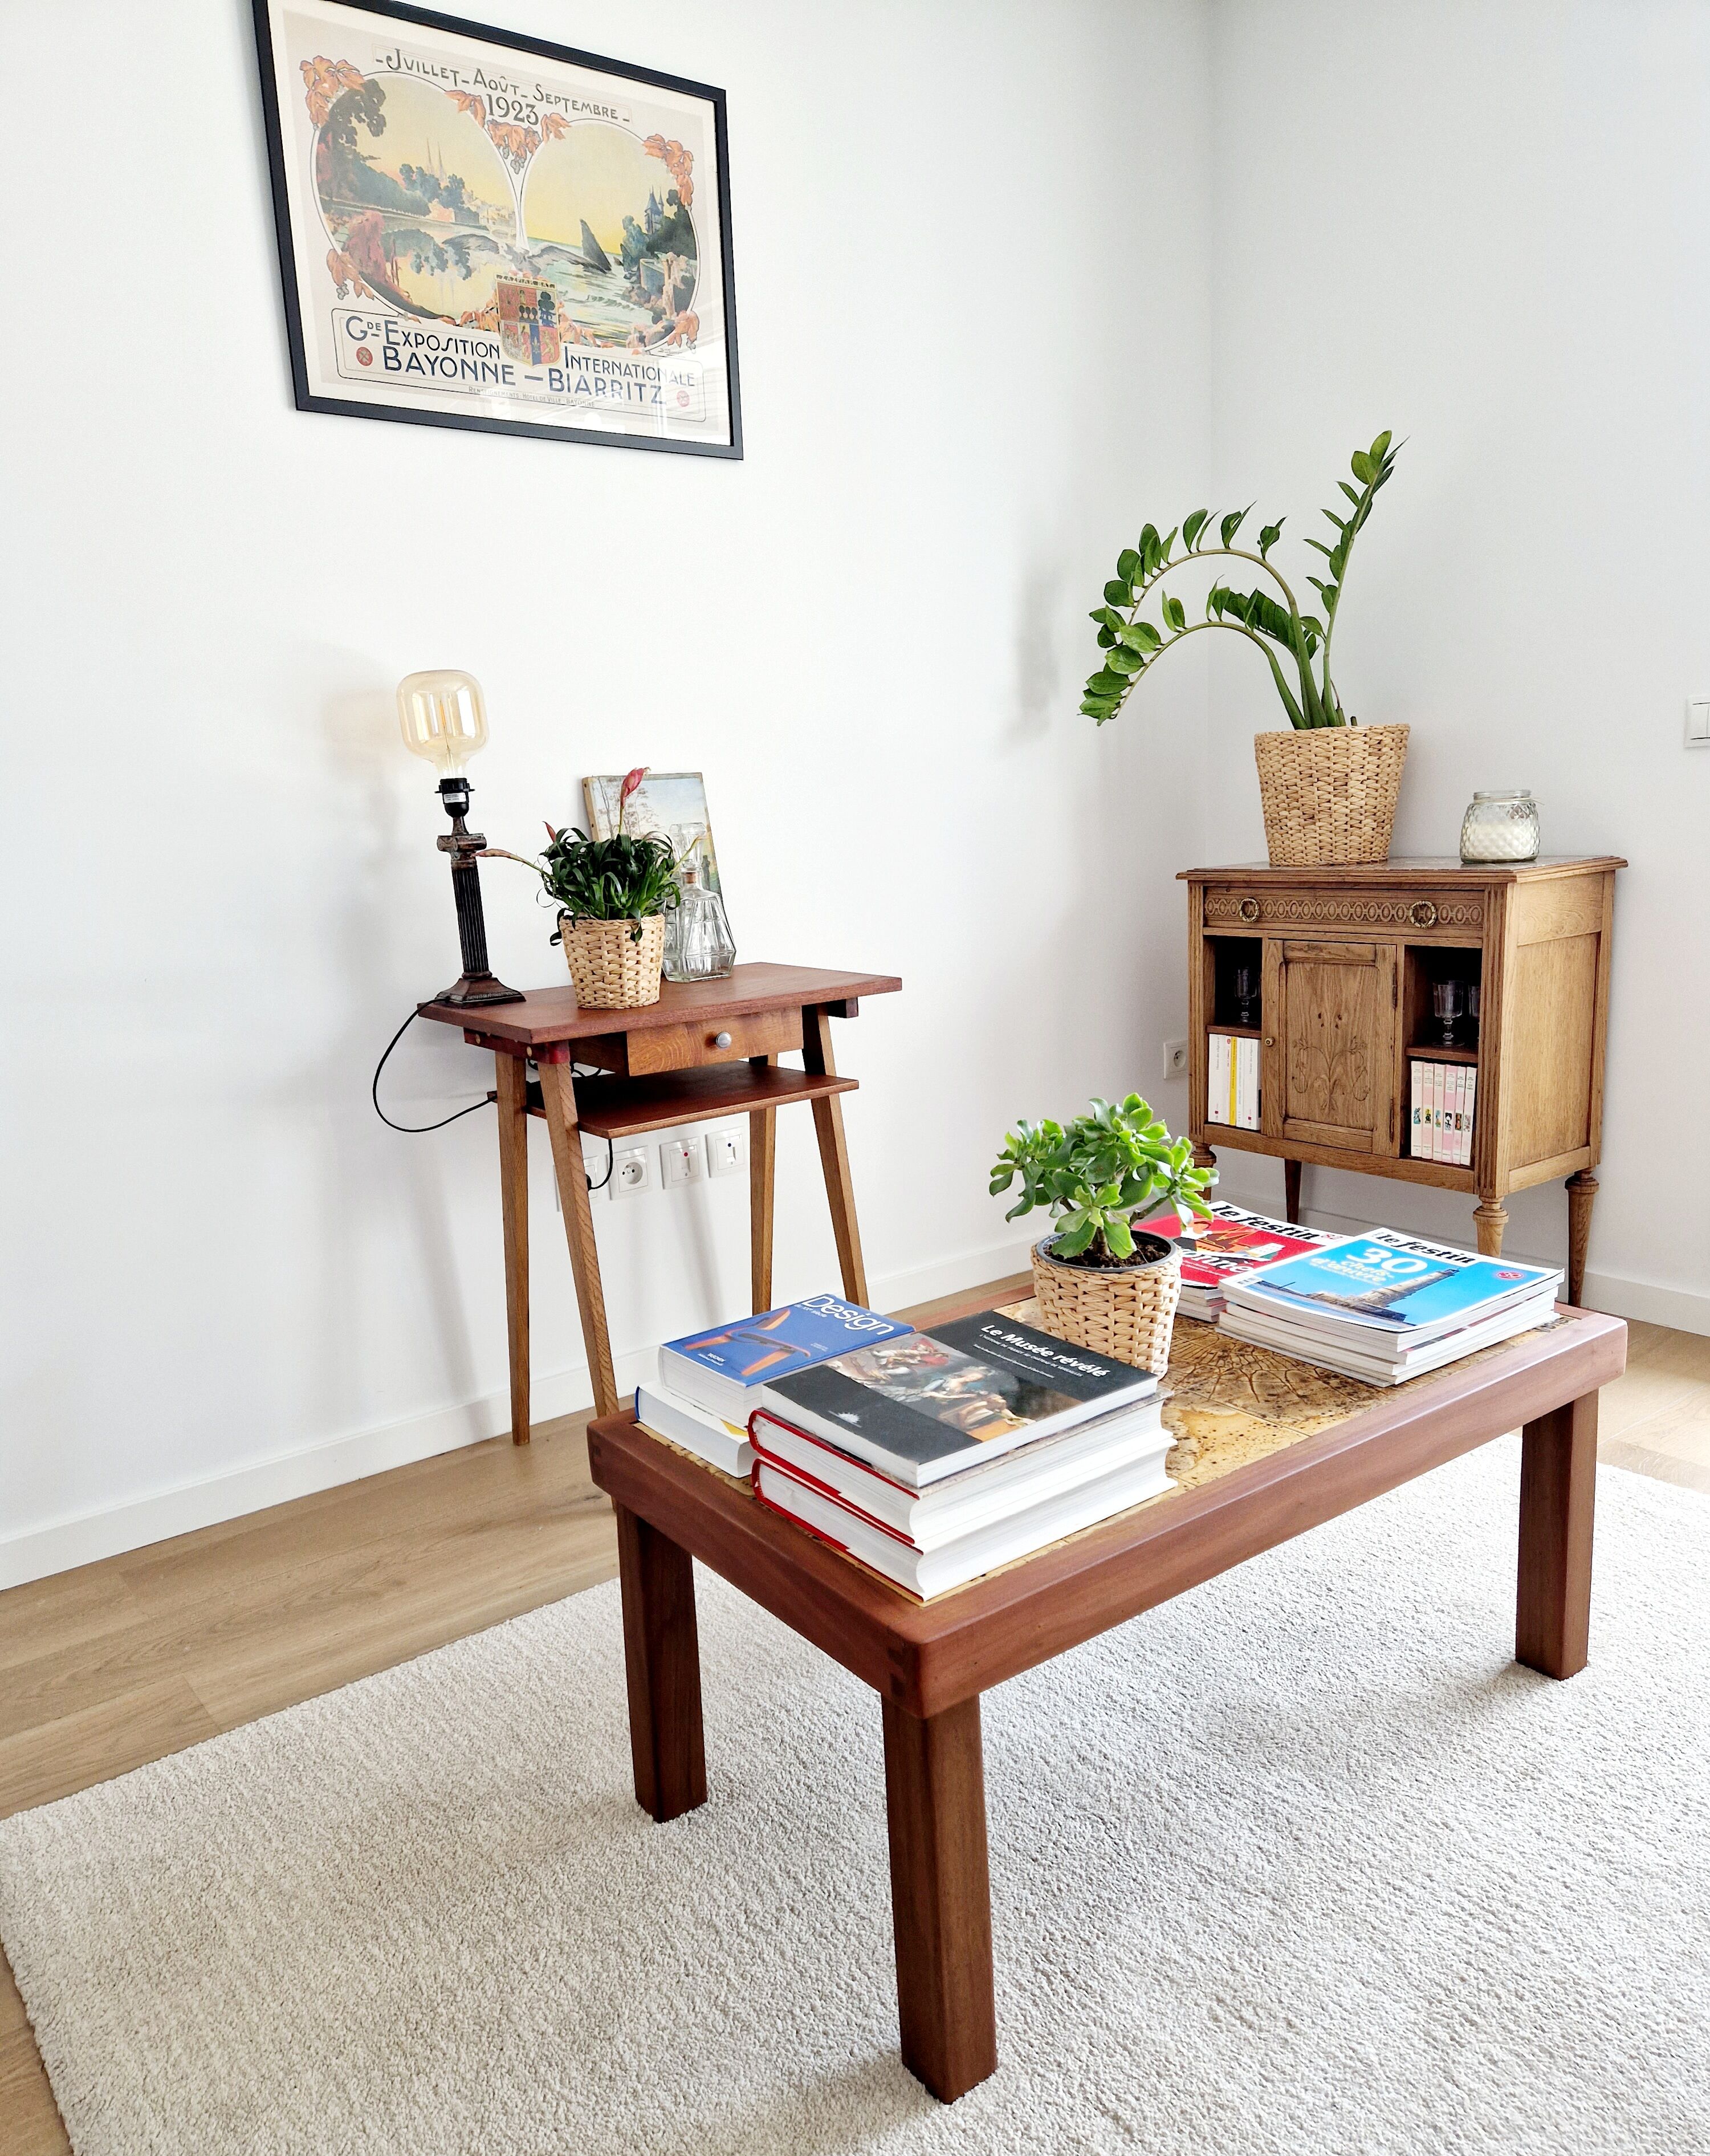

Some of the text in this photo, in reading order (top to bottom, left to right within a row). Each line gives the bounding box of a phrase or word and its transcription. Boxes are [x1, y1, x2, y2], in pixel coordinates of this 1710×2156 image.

[486, 93, 539, 125] 1923
[533, 83, 618, 119] SEPTEMBRE
[384, 320, 500, 360] EXPOSITION
[564, 345, 695, 387] INTERNATIONALE
[382, 345, 667, 405] BAYONNE BIARRITZ
[1211, 1205, 1241, 1219] le
[1228, 1216, 1320, 1240] festin
[1346, 1247, 1428, 1274] 30
[1375, 1233, 1476, 1264] le festin
[801, 1295, 894, 1335] Design
[980, 1324, 1003, 1337] Le
[1000, 1333, 1054, 1357] Musée
[1052, 1353, 1111, 1377] révélé
